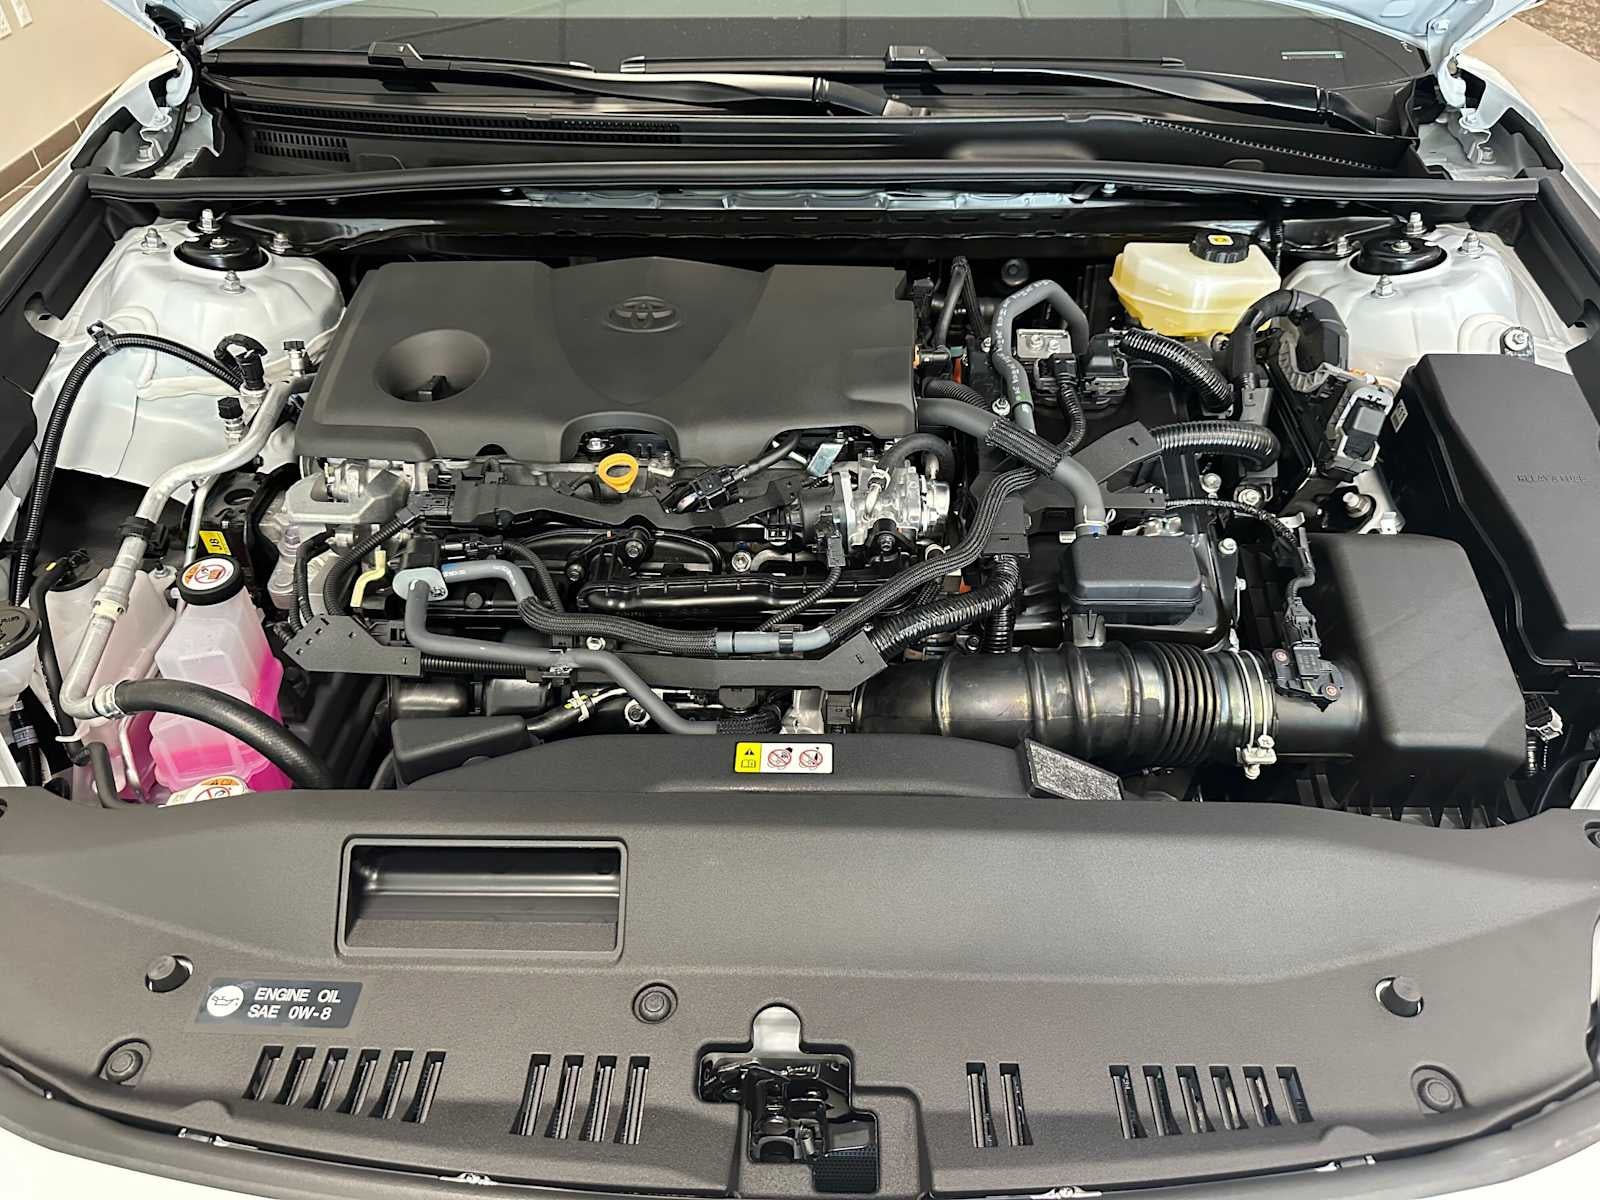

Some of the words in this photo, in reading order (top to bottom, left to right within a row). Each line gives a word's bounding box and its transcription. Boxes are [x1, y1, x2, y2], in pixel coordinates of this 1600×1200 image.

[254, 987, 311, 1002] ENGINE
[317, 989, 341, 1003] OIL
[247, 1004, 280, 1019] SAE
[288, 1006, 332, 1020] 0W-8
